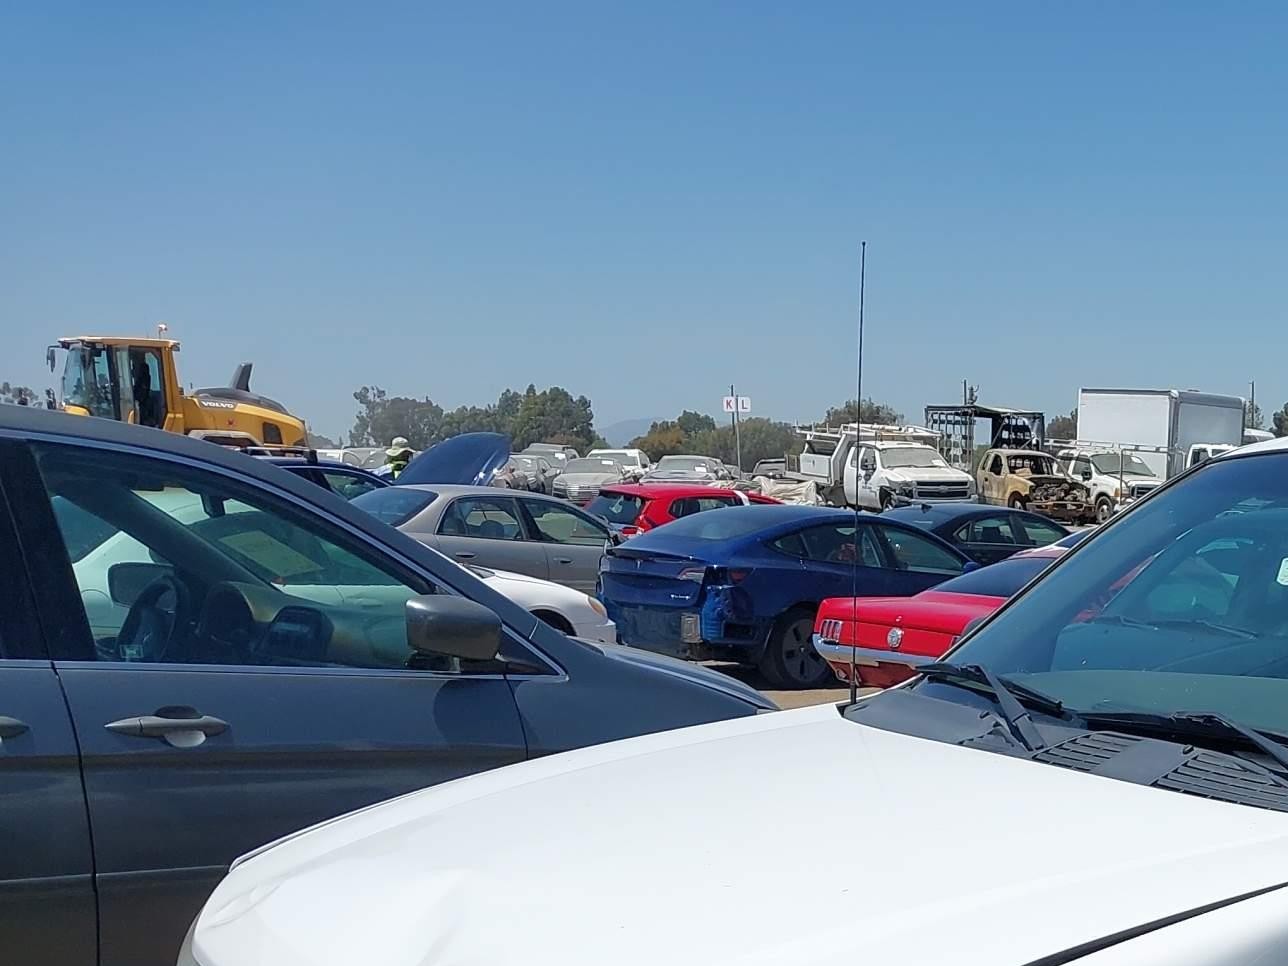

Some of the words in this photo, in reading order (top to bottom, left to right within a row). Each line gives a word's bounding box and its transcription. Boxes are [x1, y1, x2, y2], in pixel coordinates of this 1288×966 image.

[200, 400, 235, 409] VOLVO
[726, 399, 734, 410] K
[741, 399, 749, 410] L
